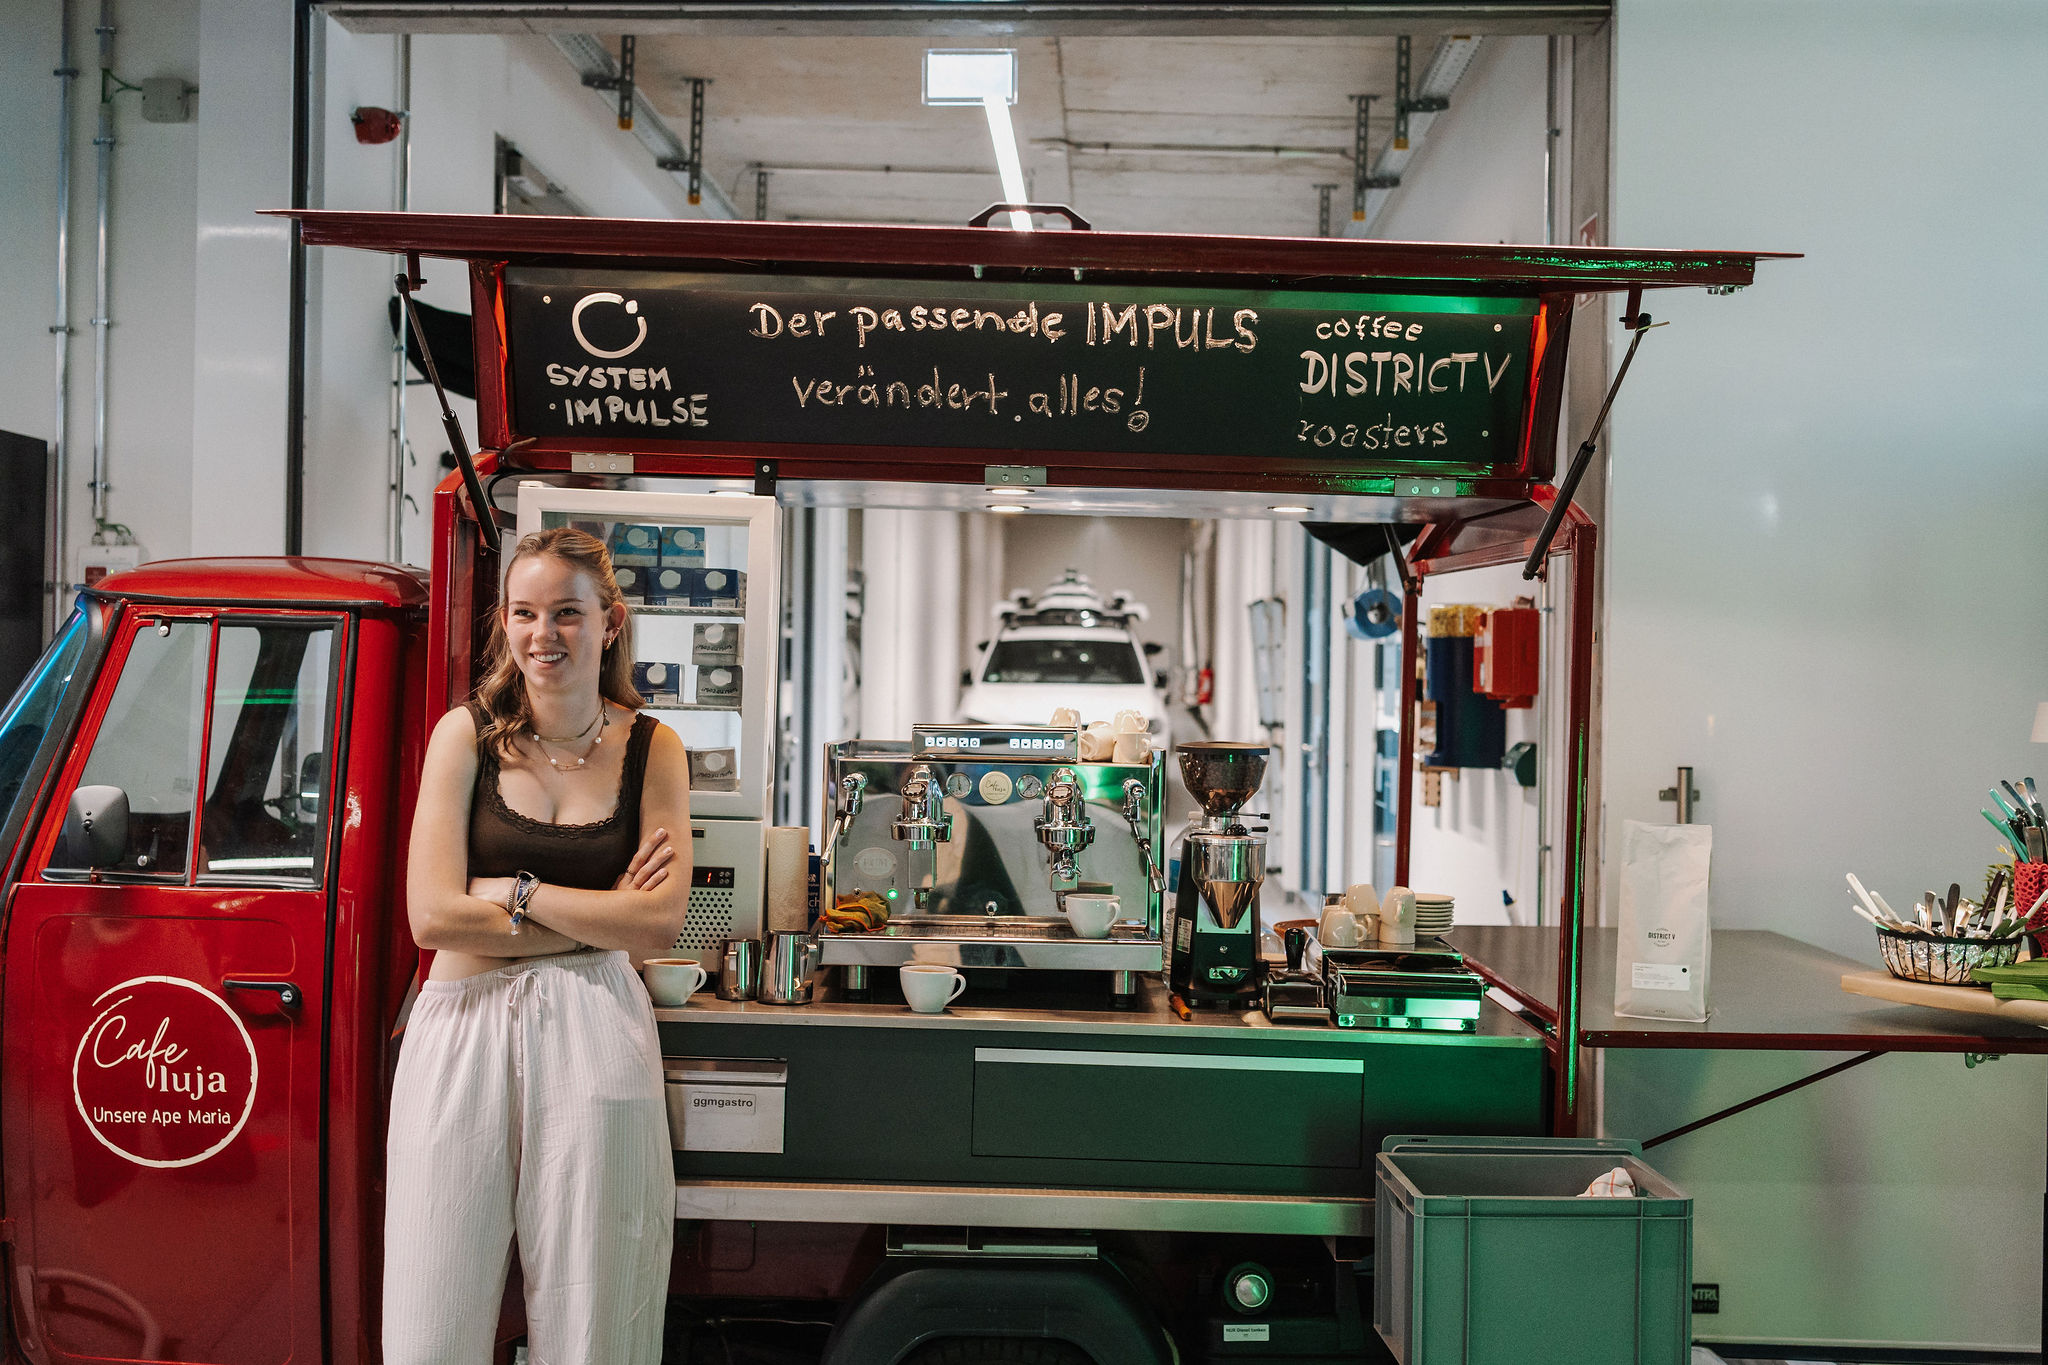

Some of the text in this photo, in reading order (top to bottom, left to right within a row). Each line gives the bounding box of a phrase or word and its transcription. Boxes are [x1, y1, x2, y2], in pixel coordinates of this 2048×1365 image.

[749, 301, 1260, 354] Der passende IMPULS
[1315, 314, 1424, 343] coffee
[546, 362, 672, 392] SYSTEM
[565, 393, 710, 428] IMPULSE
[792, 364, 1151, 433] verändert alles!
[1297, 412, 1449, 450] roasters
[1648, 932, 1671, 940] DISTRICT
[93, 1014, 189, 1089] Cafe
[159, 1064, 228, 1101] luja
[93, 1106, 231, 1127] Unsere Ape Maria
[693, 1098, 753, 1107] ggmgastro
